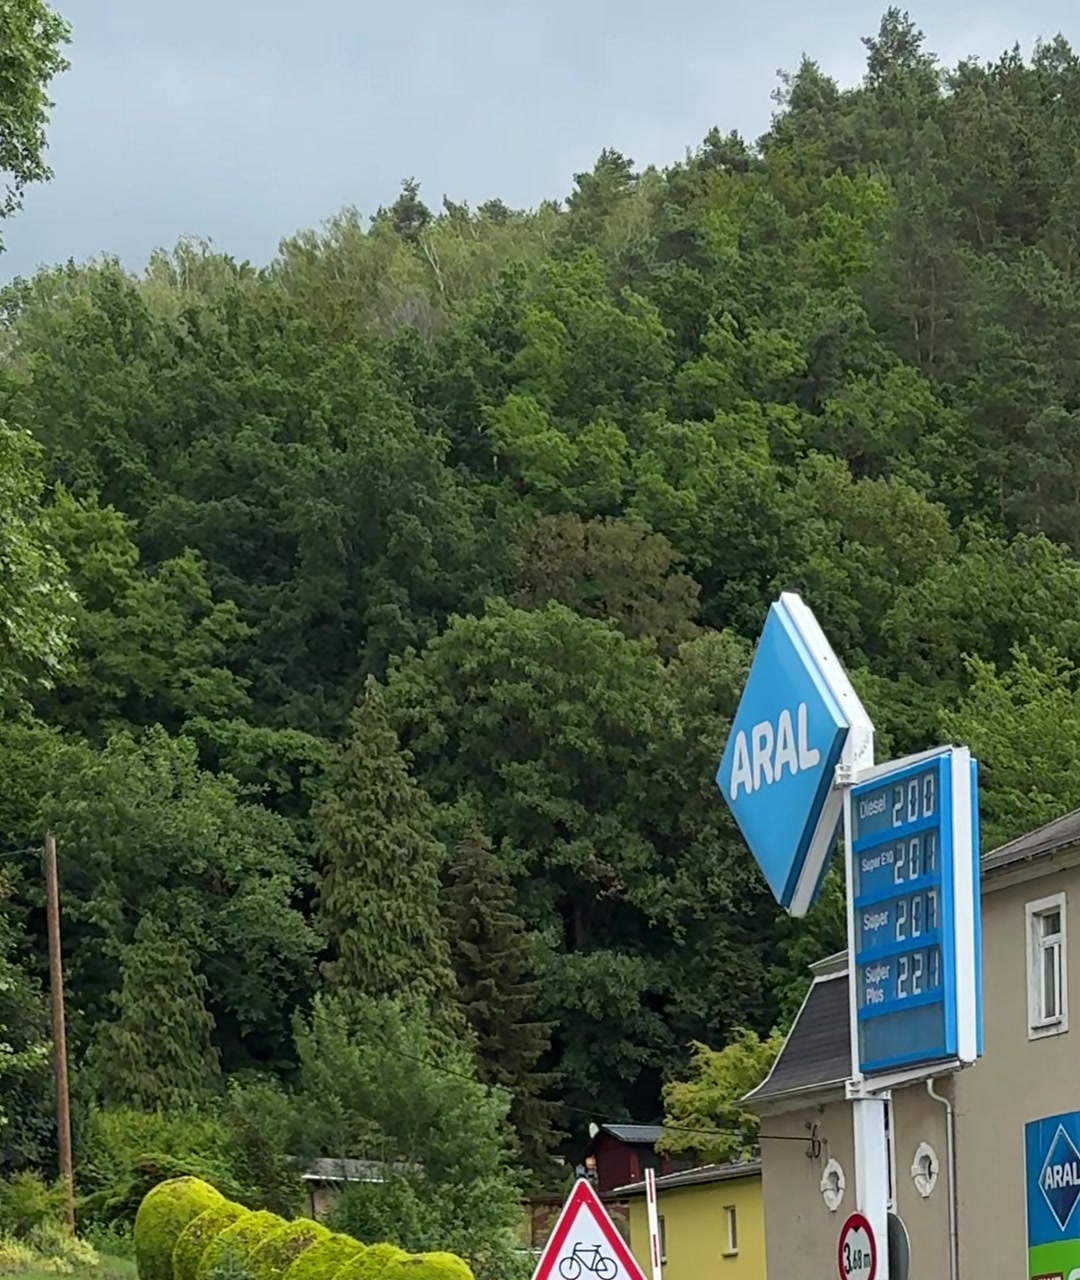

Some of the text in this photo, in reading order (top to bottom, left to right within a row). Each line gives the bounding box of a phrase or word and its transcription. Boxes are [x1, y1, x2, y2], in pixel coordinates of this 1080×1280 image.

[730, 702, 820, 801] ARAL
[860, 773, 935, 828] Diesel 200
[862, 835, 936, 885] Super E10 201
[863, 890, 938, 942] Super 207
[865, 950, 939, 999] Super 221
[866, 986, 885, 1005] Plus
